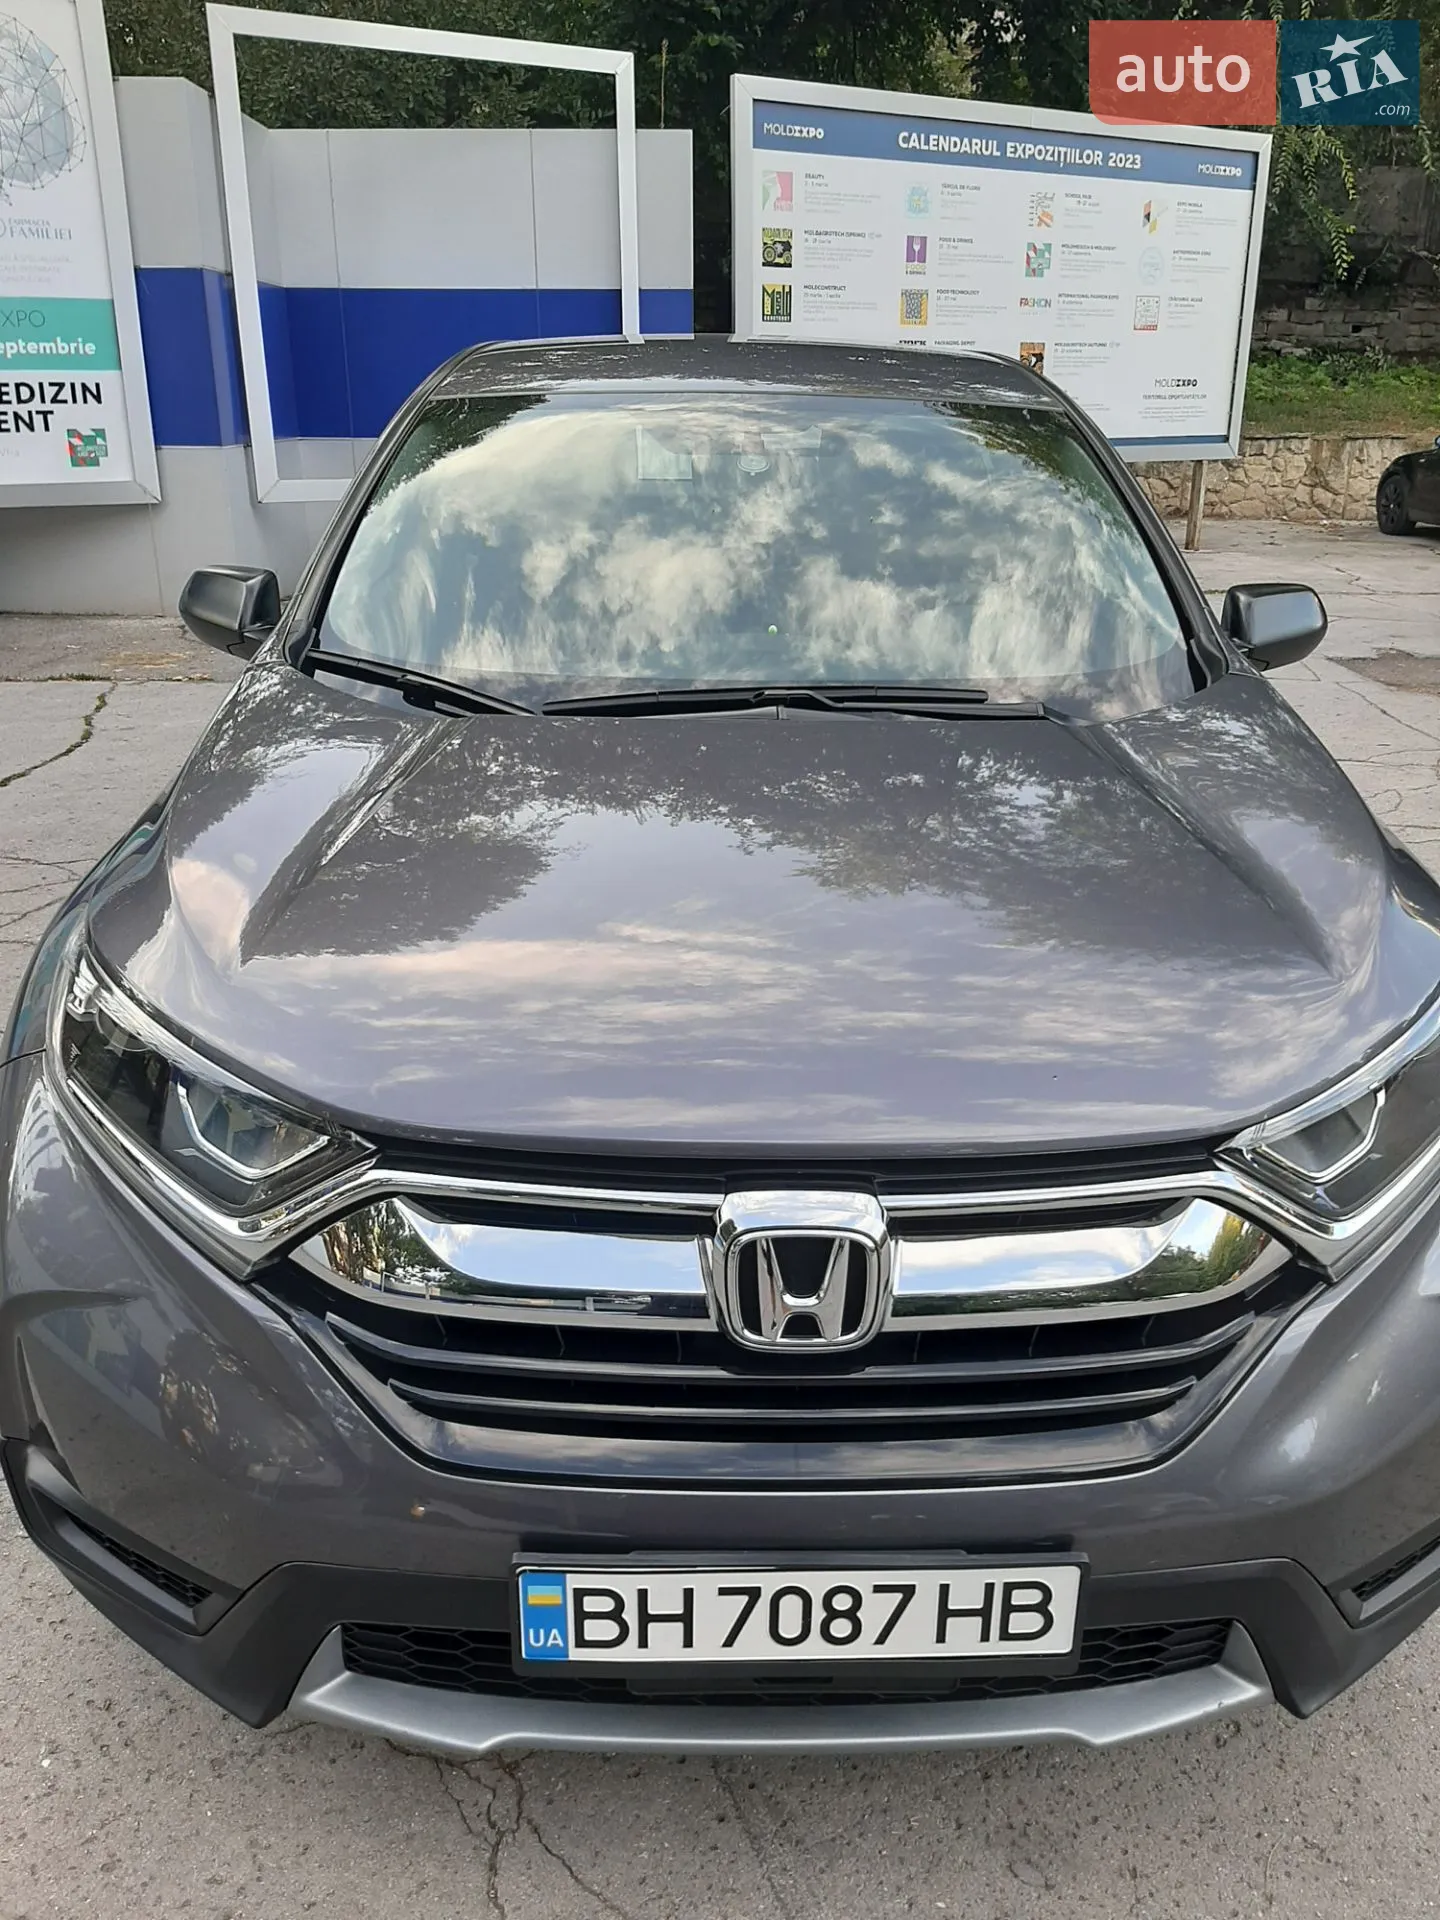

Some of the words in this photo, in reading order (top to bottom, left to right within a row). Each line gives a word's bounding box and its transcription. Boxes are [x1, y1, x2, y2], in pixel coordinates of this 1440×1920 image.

[898, 131, 1001, 157] CALENDARUL
[1108, 152, 1142, 169] 2023
[9, 226, 72, 240] FAMILIEI
[1019, 297, 1052, 308] FASHION
[572, 1587, 694, 1649] BH
[716, 1584, 916, 1649] 7087
[935, 1580, 1054, 1644] HB
[529, 1628, 564, 1648] UA
